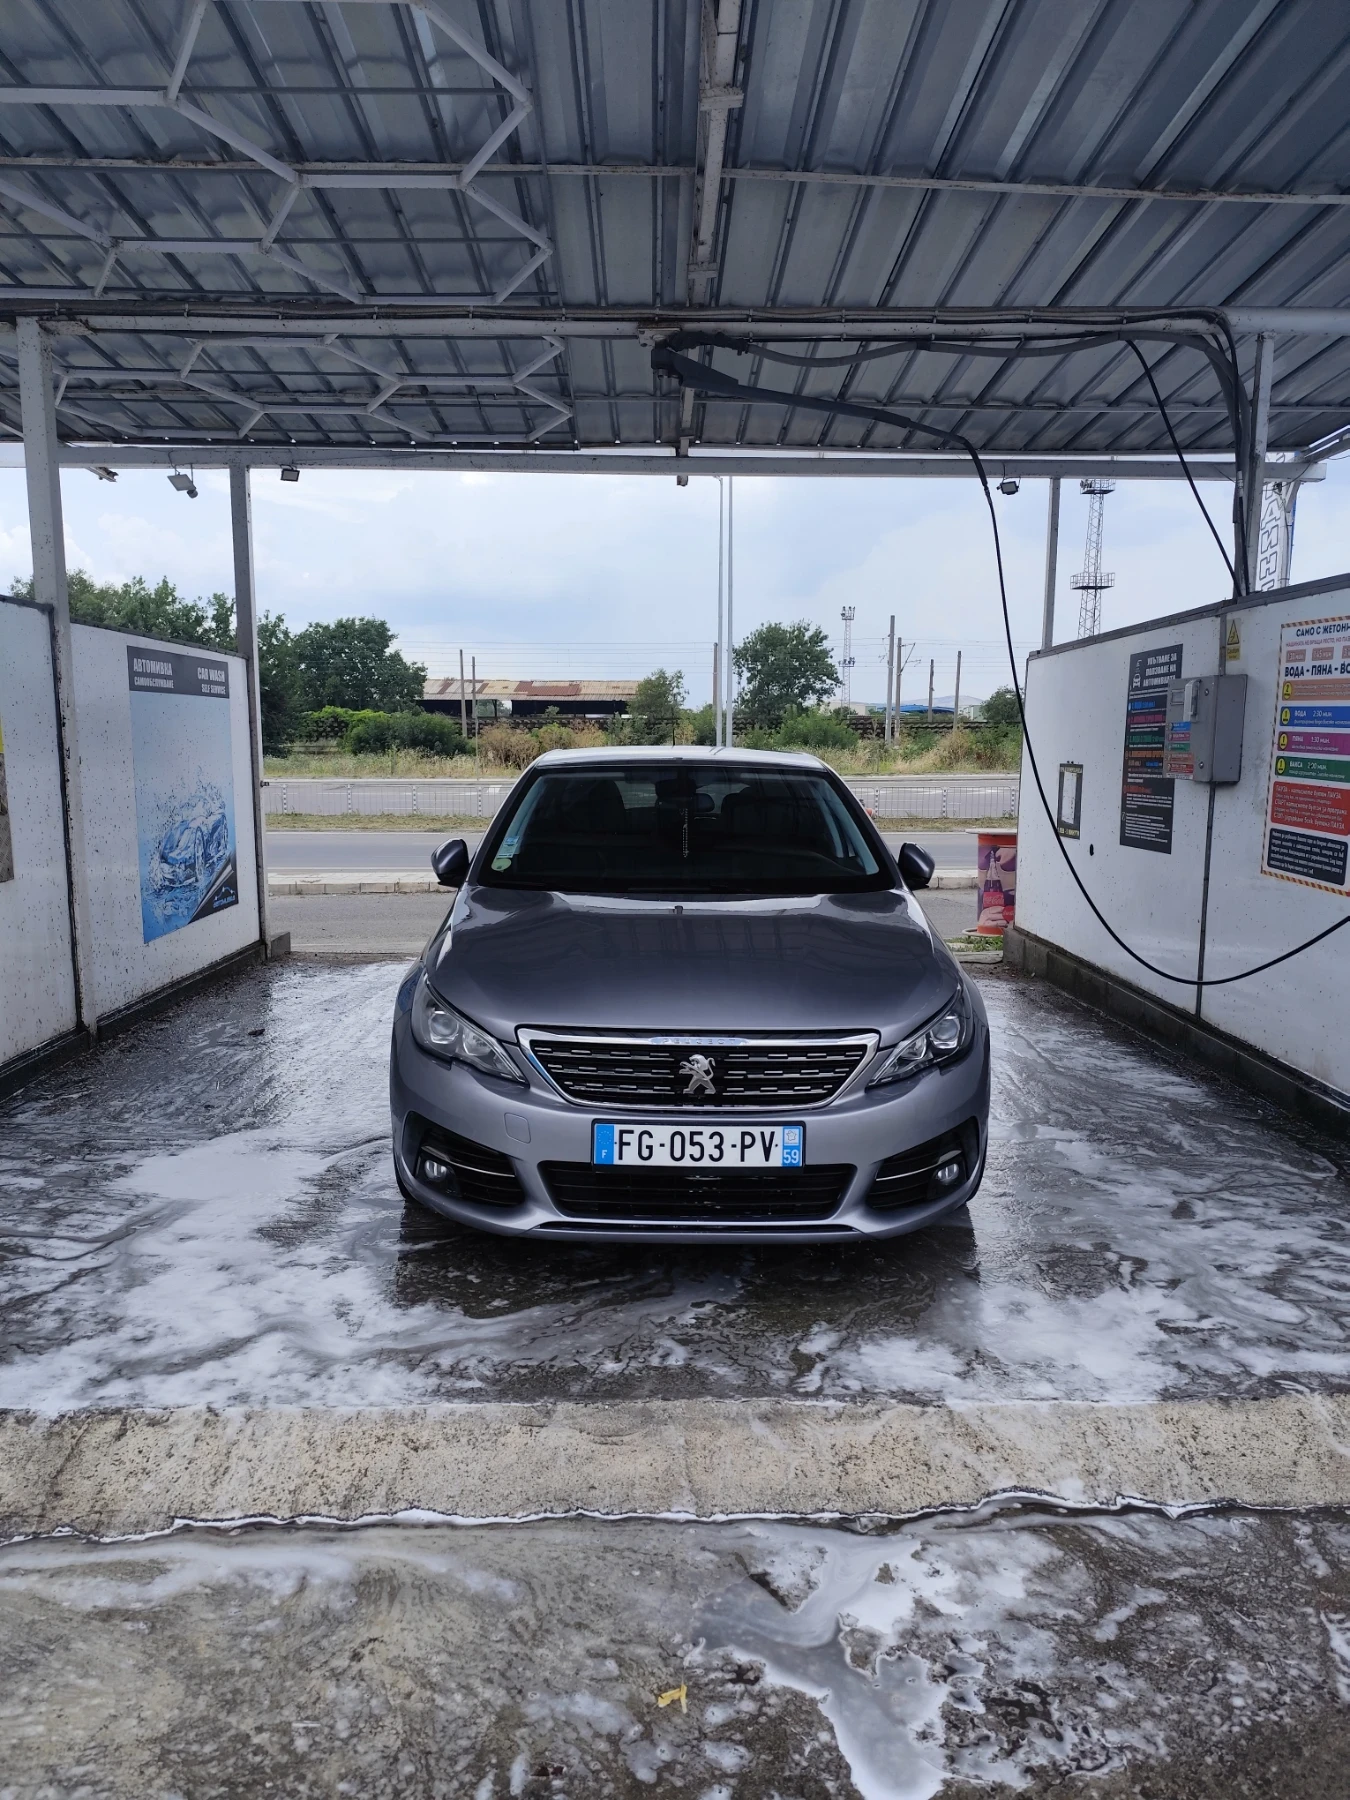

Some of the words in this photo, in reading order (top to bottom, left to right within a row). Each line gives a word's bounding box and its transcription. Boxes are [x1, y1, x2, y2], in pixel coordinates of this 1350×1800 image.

[1296, 628, 1315, 637] САМО
[1316, 626, 1321, 635] С
[133, 658, 172, 676] АВТОМИВКА
[197, 667, 209, 680] CAR
[209, 668, 225, 682] WASH
[1285, 666, 1304, 678] ВОДА
[1311, 664, 1332, 676] ПЯНА
[601, 1149, 608, 1159] F
[618, 1129, 775, 1163] FG-053-PV
[783, 1149, 799, 1164] 59
